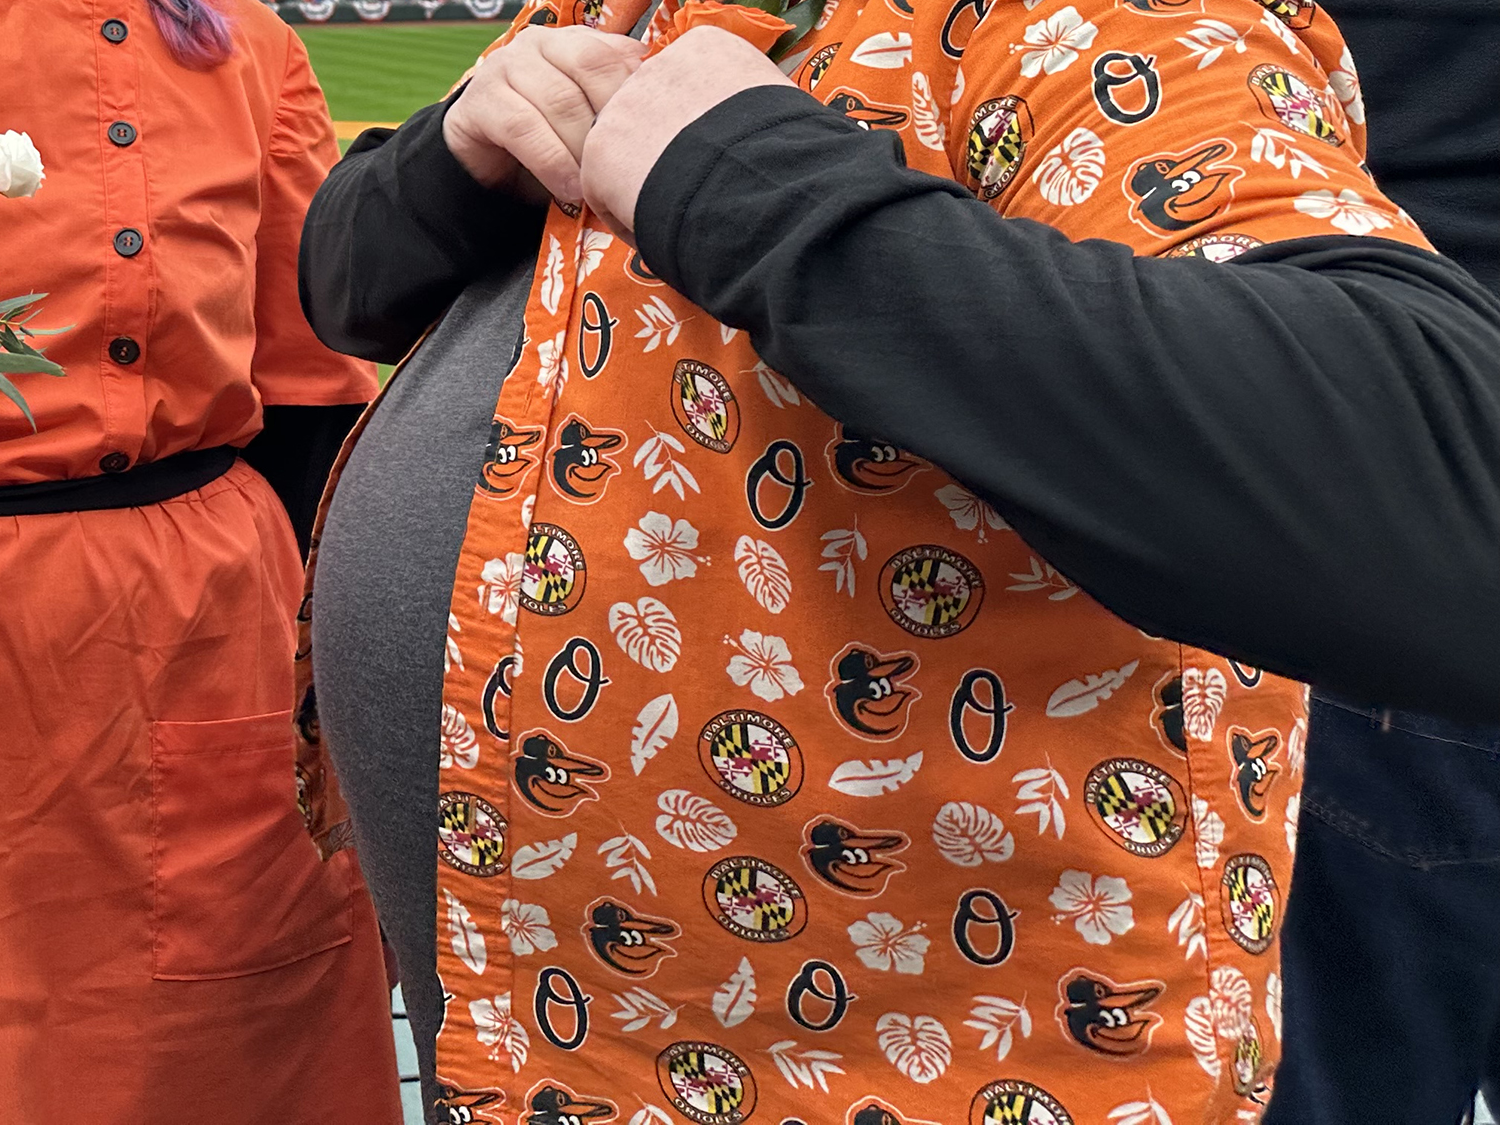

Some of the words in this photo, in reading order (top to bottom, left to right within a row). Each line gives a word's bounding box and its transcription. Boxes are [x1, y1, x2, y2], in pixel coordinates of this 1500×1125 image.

[1091, 50, 1162, 127] O
[578, 290, 620, 381] O
[745, 438, 815, 532] O
[890, 547, 982, 588] BALTIMORE
[543, 636, 612, 723] O
[949, 668, 1016, 764] O
[703, 713, 794, 749] BALTIMORE
[1086, 760, 1172, 804] BALTIMORE
[952, 887, 1021, 967] O
[533, 965, 594, 1051] O
[785, 958, 859, 1033] O
[668, 1043, 749, 1078] ALTIMORE
[673, 1096, 744, 1124] ORIOLES
